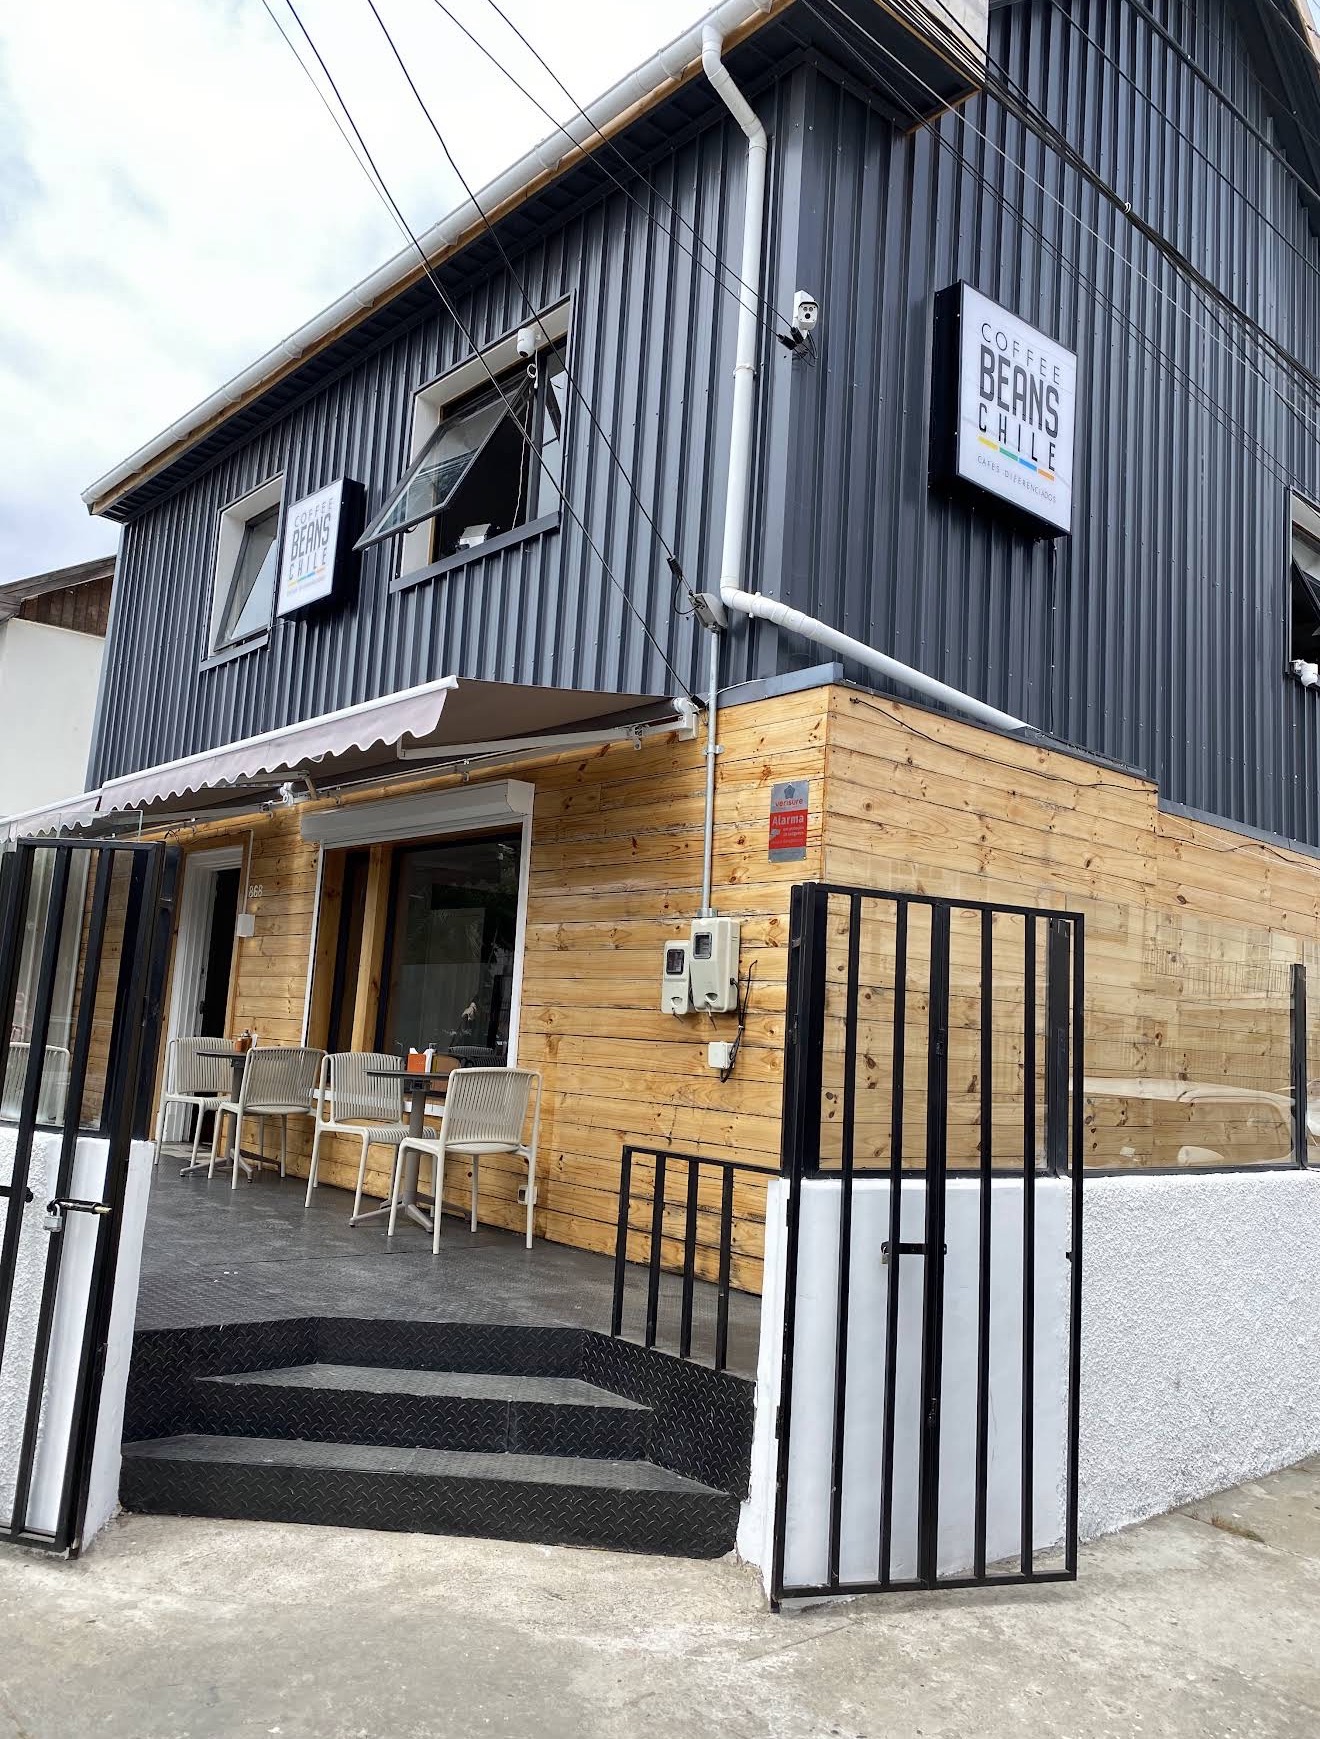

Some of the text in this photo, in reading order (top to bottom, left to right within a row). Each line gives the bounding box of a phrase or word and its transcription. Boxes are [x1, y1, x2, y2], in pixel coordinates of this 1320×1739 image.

[981, 322, 1061, 386] COFFEE
[979, 343, 1060, 439] BEANS
[978, 402, 1056, 472] CHILE
[294, 497, 333, 528] COFFEE
[290, 513, 331, 562] BEANS
[289, 547, 327, 581] CHILE
[772, 814, 804, 826] Alarma
[249, 884, 263, 898] 868
